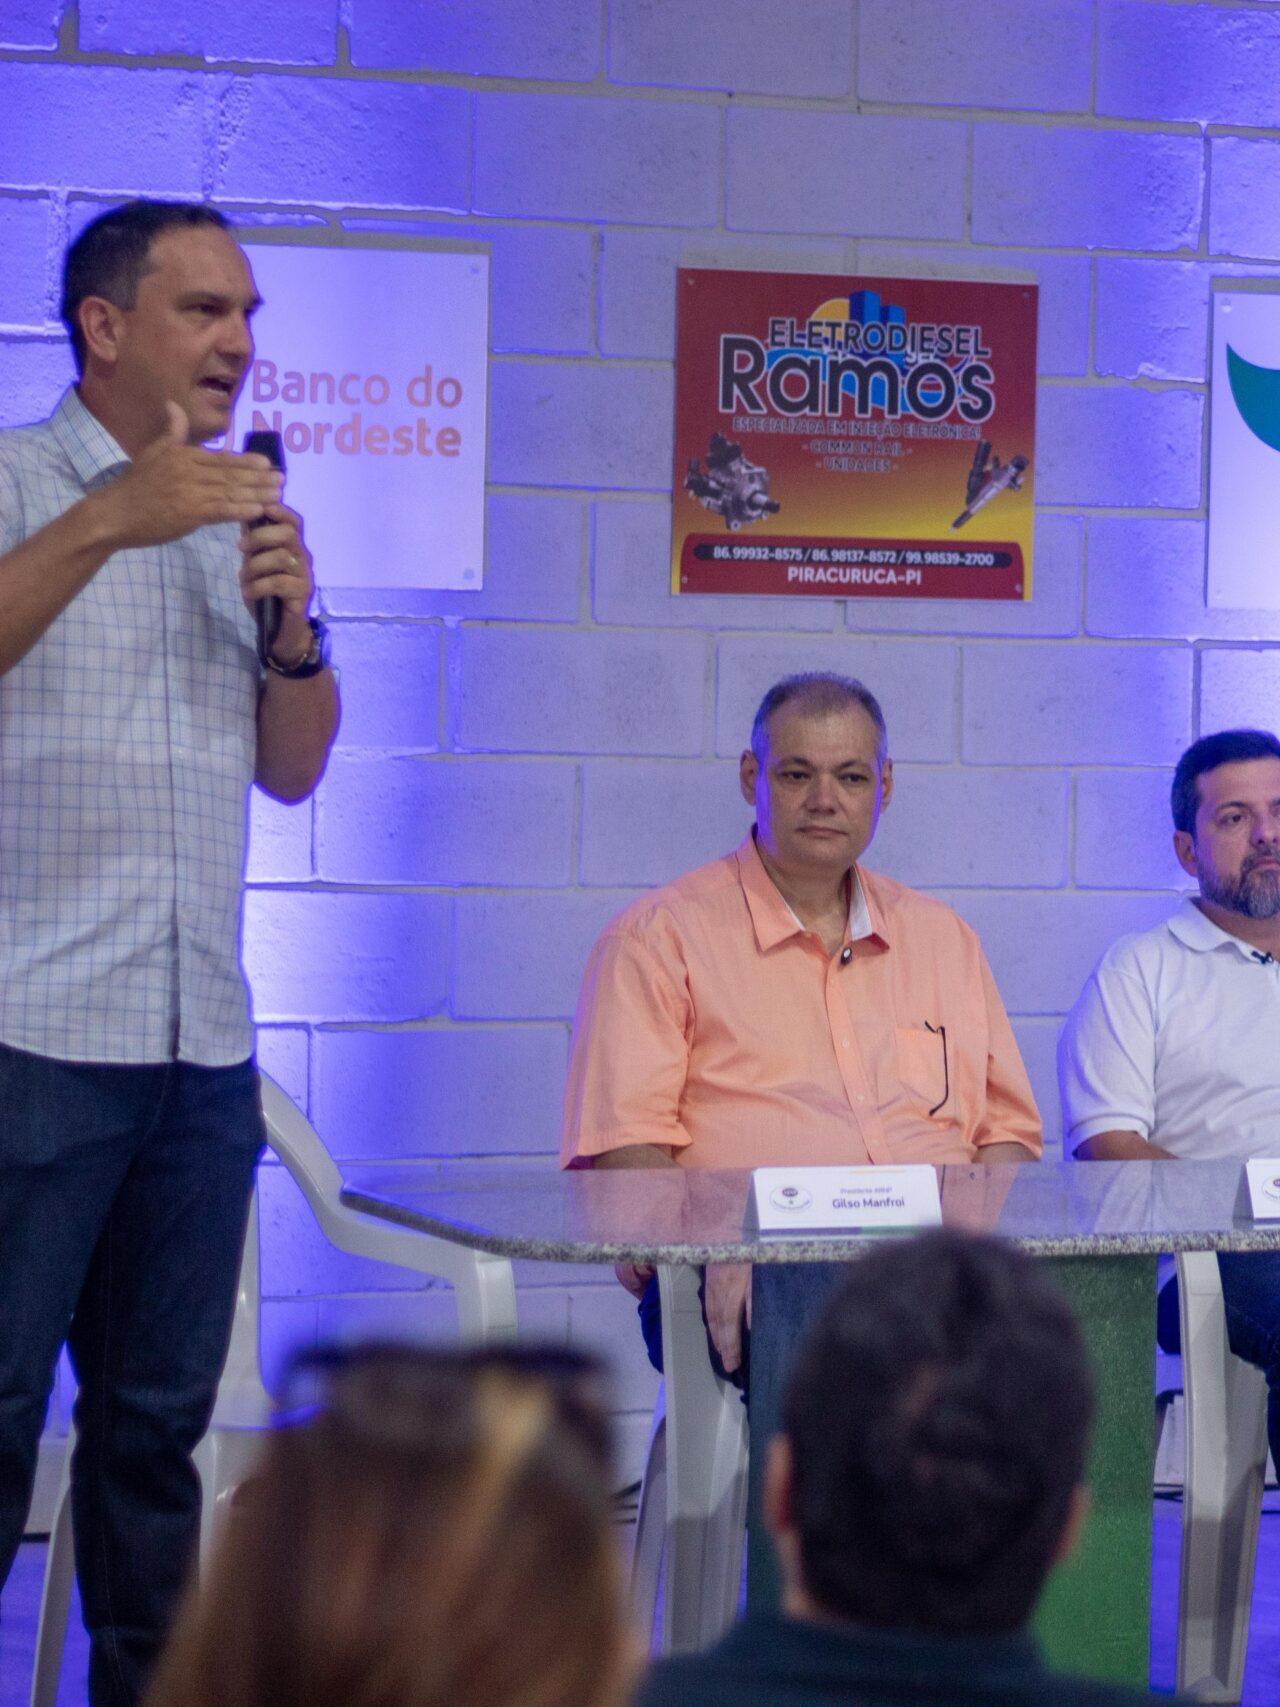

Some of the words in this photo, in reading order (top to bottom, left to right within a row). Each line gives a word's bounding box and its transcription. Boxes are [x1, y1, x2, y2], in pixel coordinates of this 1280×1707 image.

[769, 316, 990, 357] ELETRODIESEL
[252, 359, 390, 405] Banco
[406, 364, 463, 409] do
[719, 334, 995, 424] Ramos
[732, 416, 825, 434] ESPECIALIZADA
[827, 419, 847, 435] EM
[849, 418, 902, 441] INJEÇÃO
[823, 457, 891, 474] UNIDADES
[787, 567, 922, 585] PIRACURUCA-PI
[832, 1198, 860, 1208] Gilso
